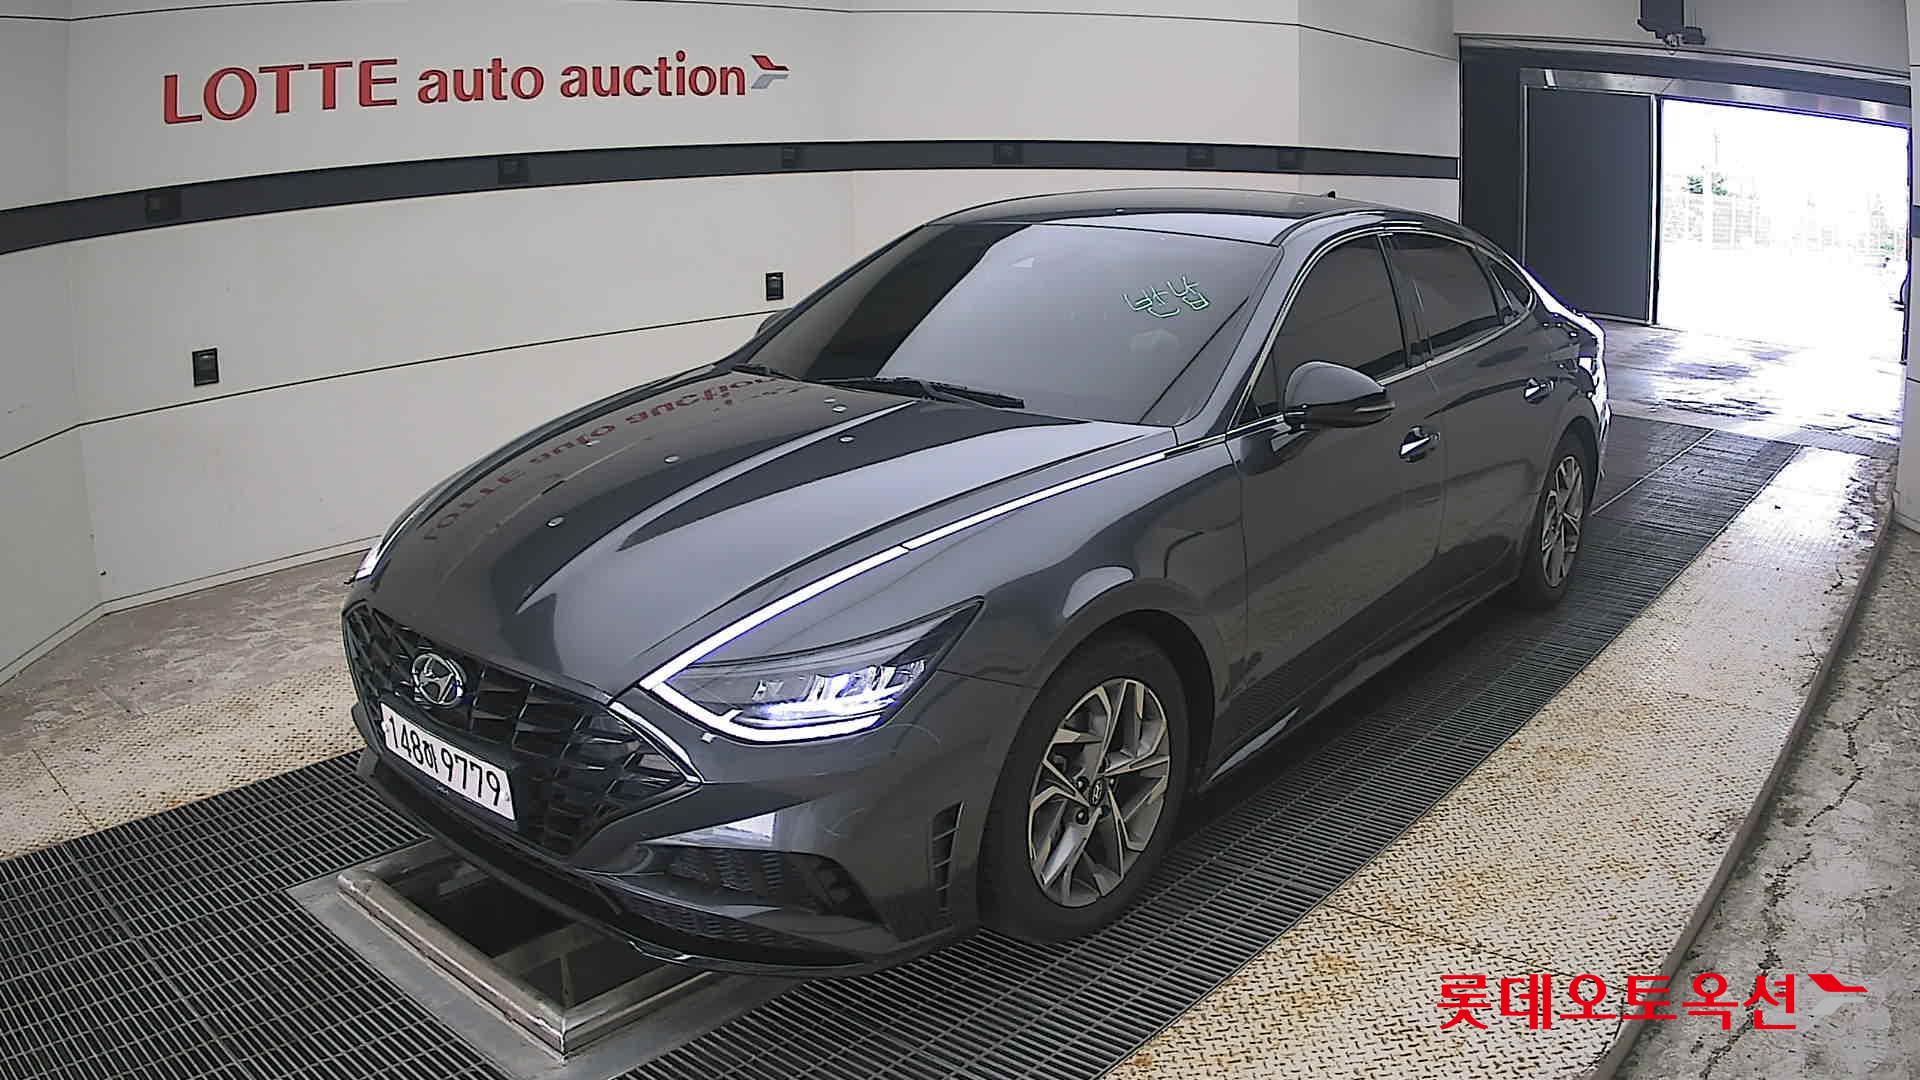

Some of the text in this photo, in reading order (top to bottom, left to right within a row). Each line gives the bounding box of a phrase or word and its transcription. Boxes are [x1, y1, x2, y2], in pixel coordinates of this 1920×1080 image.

[162, 50, 747, 125] LOTTE auto auction
[1123, 275, 1210, 318] 반납
